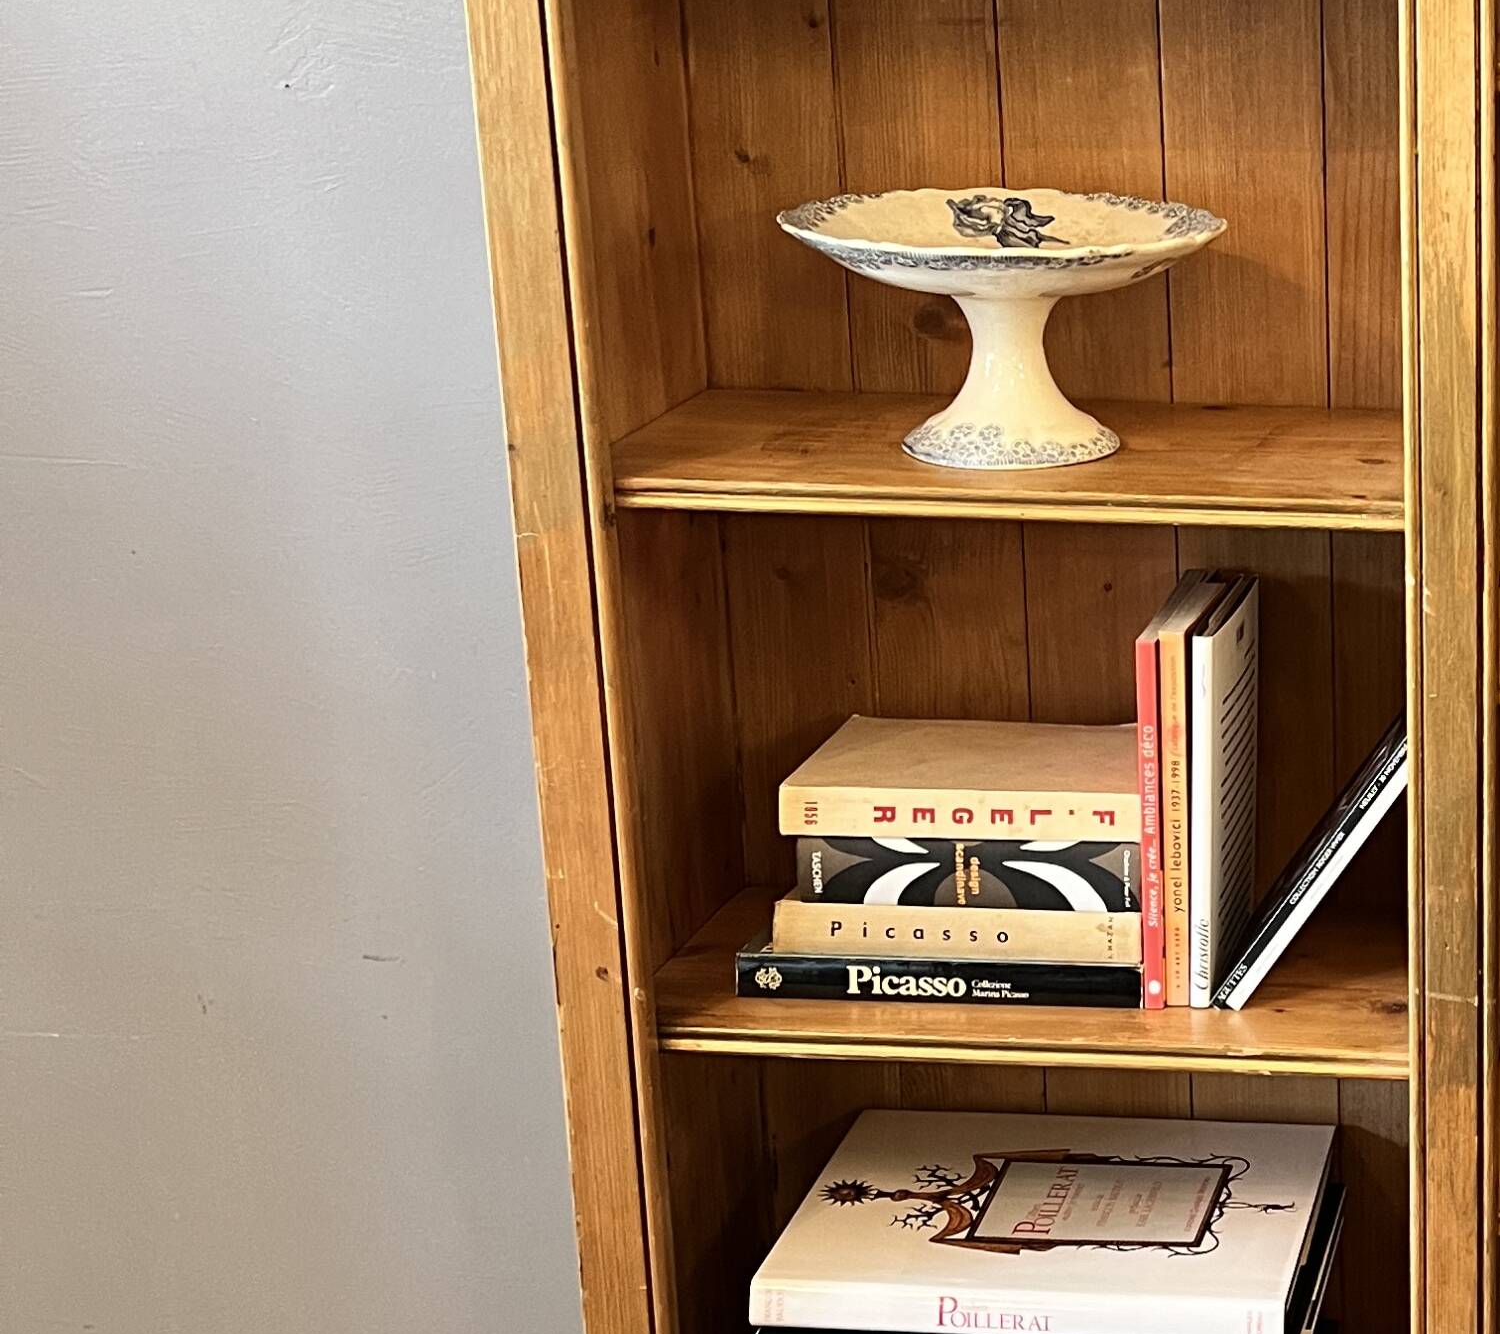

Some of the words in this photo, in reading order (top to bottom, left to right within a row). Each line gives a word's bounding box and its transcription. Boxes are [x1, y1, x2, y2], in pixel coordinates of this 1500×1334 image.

[1141, 725, 1155, 758] déco
[1142, 762, 1156, 835] Ambiances
[1170, 760, 1182, 812] 1937-1998
[1168, 820, 1182, 871] lebovici
[813, 850, 824, 895] TASCHEN
[955, 842, 967, 906] scandinave
[968, 856, 981, 896] design
[1147, 886, 1160, 928] Silence,
[1170, 876, 1186, 913] yonel
[830, 920, 1009, 944] Picasso
[846, 965, 967, 997] Picasso
[936, 1296, 1053, 1332] POILLERAT
